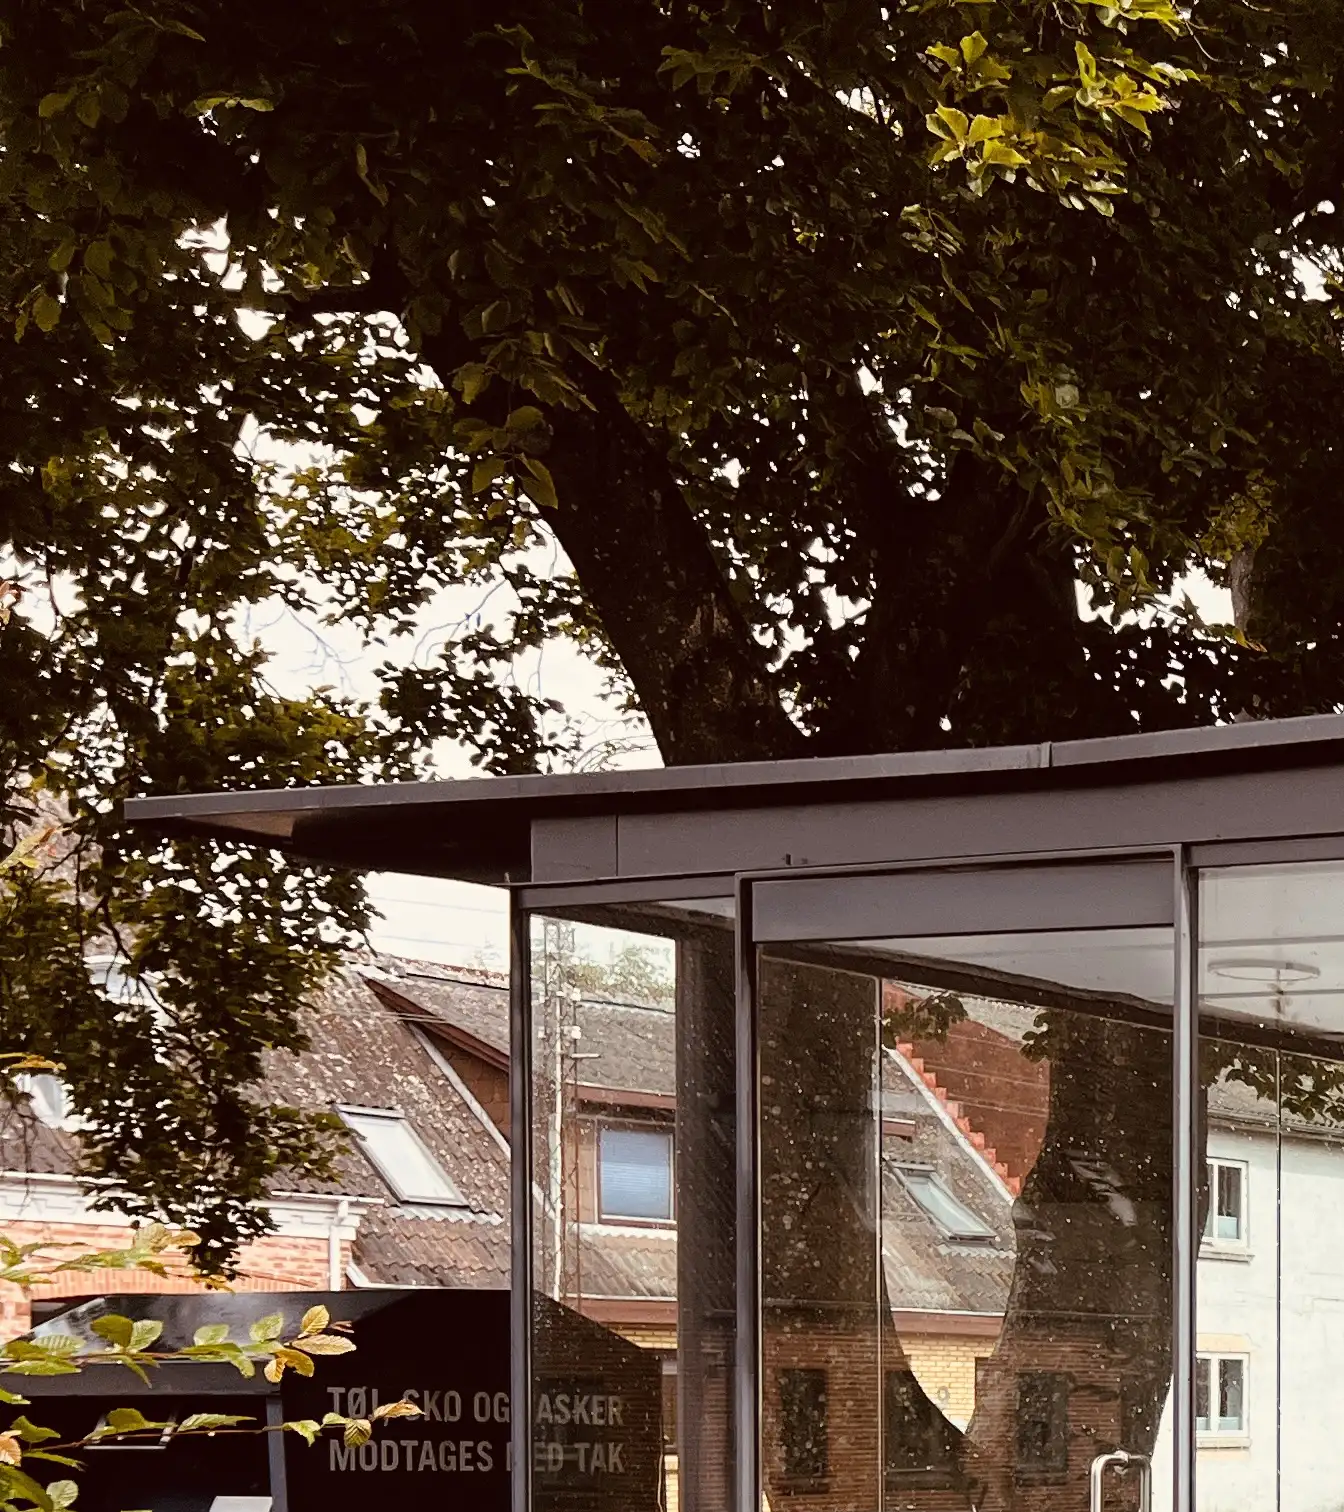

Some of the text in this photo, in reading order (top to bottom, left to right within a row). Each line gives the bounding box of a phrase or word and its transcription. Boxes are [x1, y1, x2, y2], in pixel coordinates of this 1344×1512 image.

[474, 1391, 510, 1423] OG
[535, 1393, 625, 1426] ASKER
[330, 1439, 625, 1476] MODTAGES ED TAK
